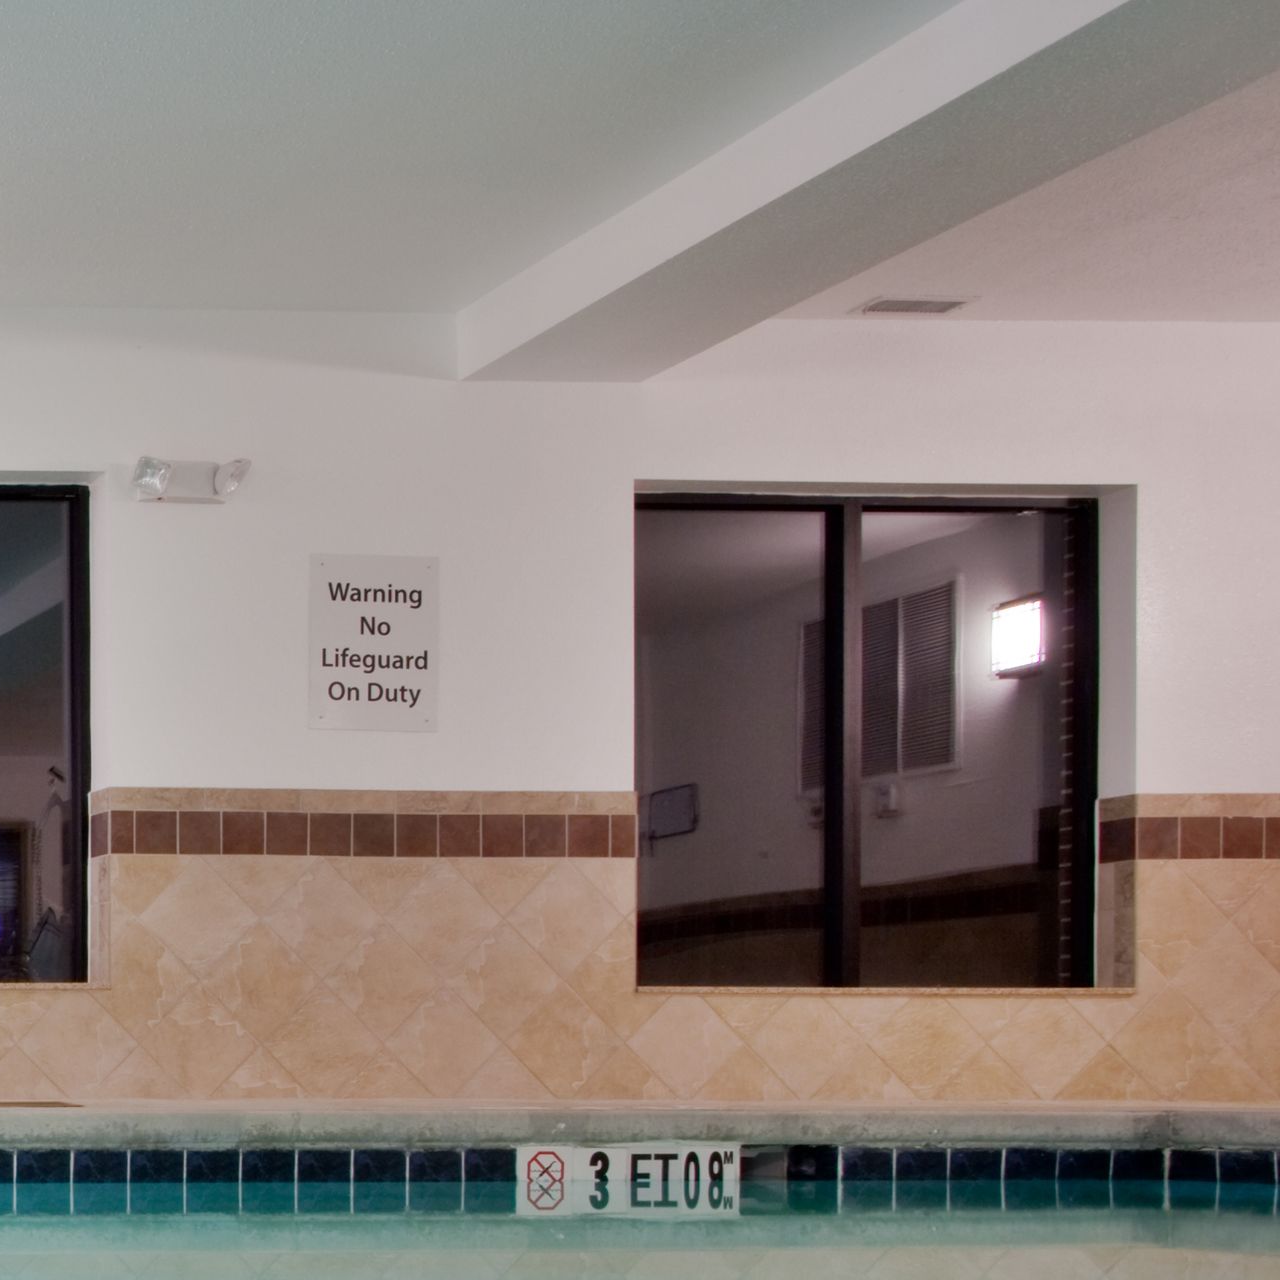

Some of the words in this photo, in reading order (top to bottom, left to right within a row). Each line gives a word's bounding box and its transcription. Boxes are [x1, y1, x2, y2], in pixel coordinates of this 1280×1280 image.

[328, 582, 423, 609] Warning
[360, 616, 391, 636] No
[322, 647, 428, 674] Lifeguard
[328, 681, 360, 702] On
[367, 682, 422, 708] Duty
